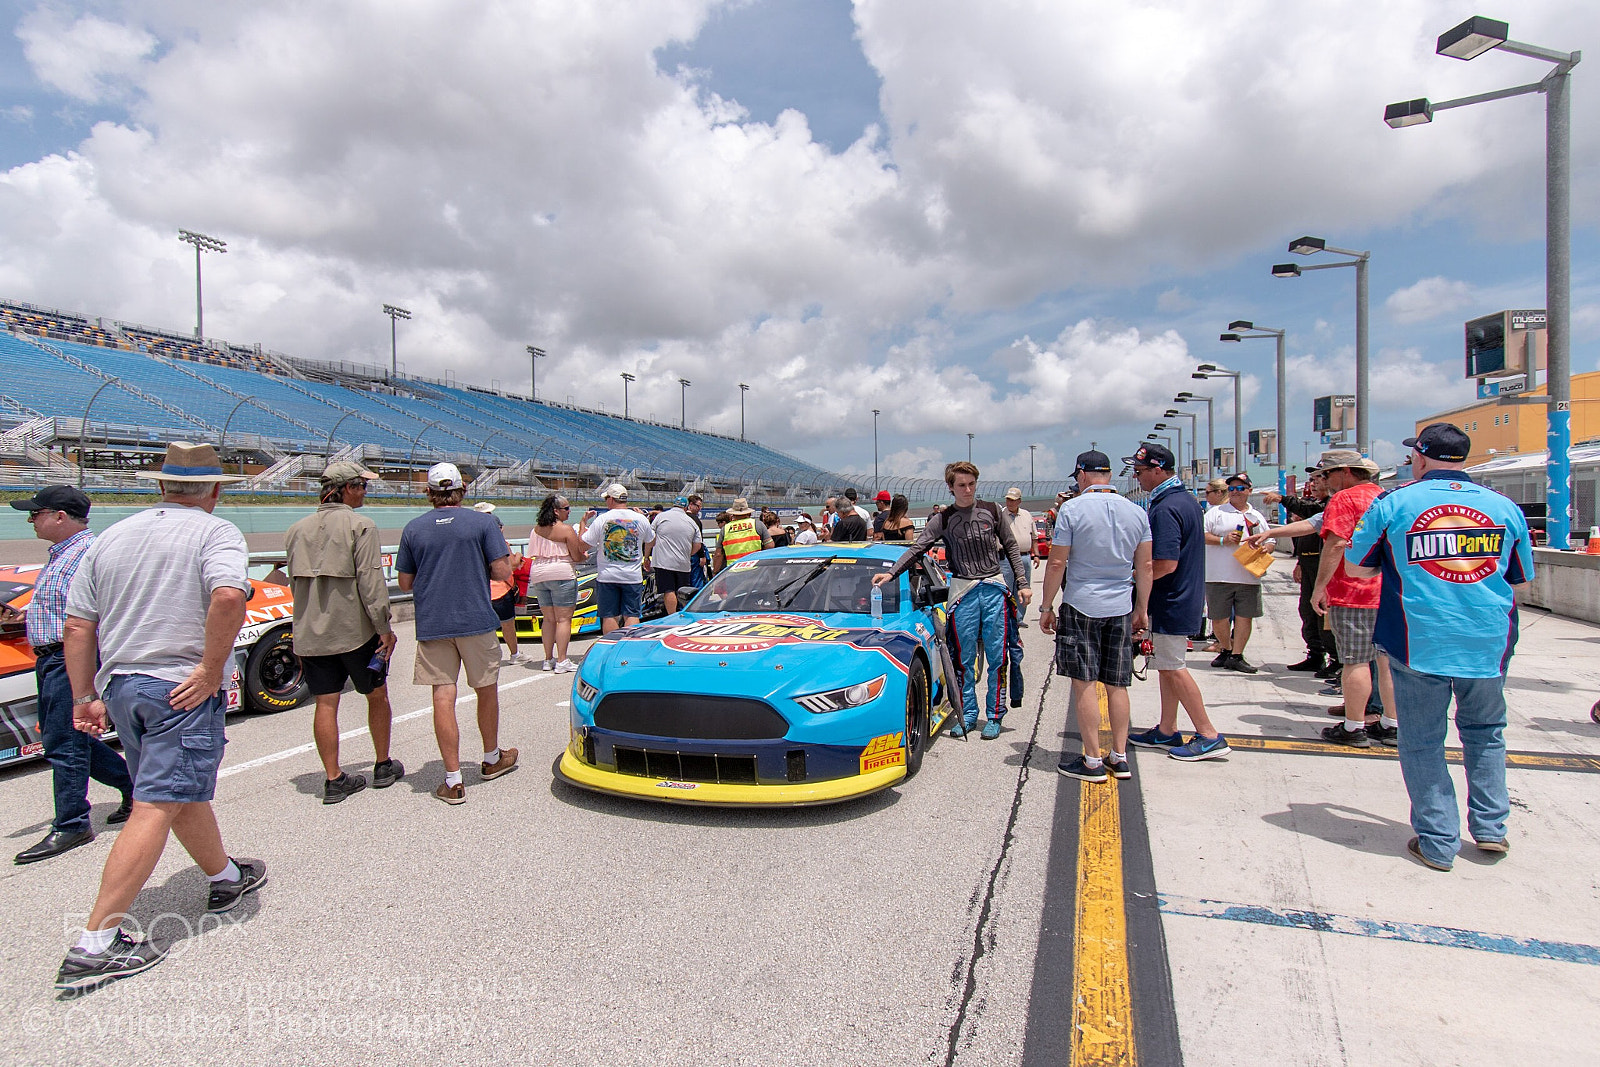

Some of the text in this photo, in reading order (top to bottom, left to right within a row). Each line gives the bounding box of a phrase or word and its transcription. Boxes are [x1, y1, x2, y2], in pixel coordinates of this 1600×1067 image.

[1447, 506, 1488, 524] LAWLESS
[258, 690, 297, 707] PIRELLI
[859, 731, 904, 757] AEM
[863, 752, 901, 771] PIRELLI
